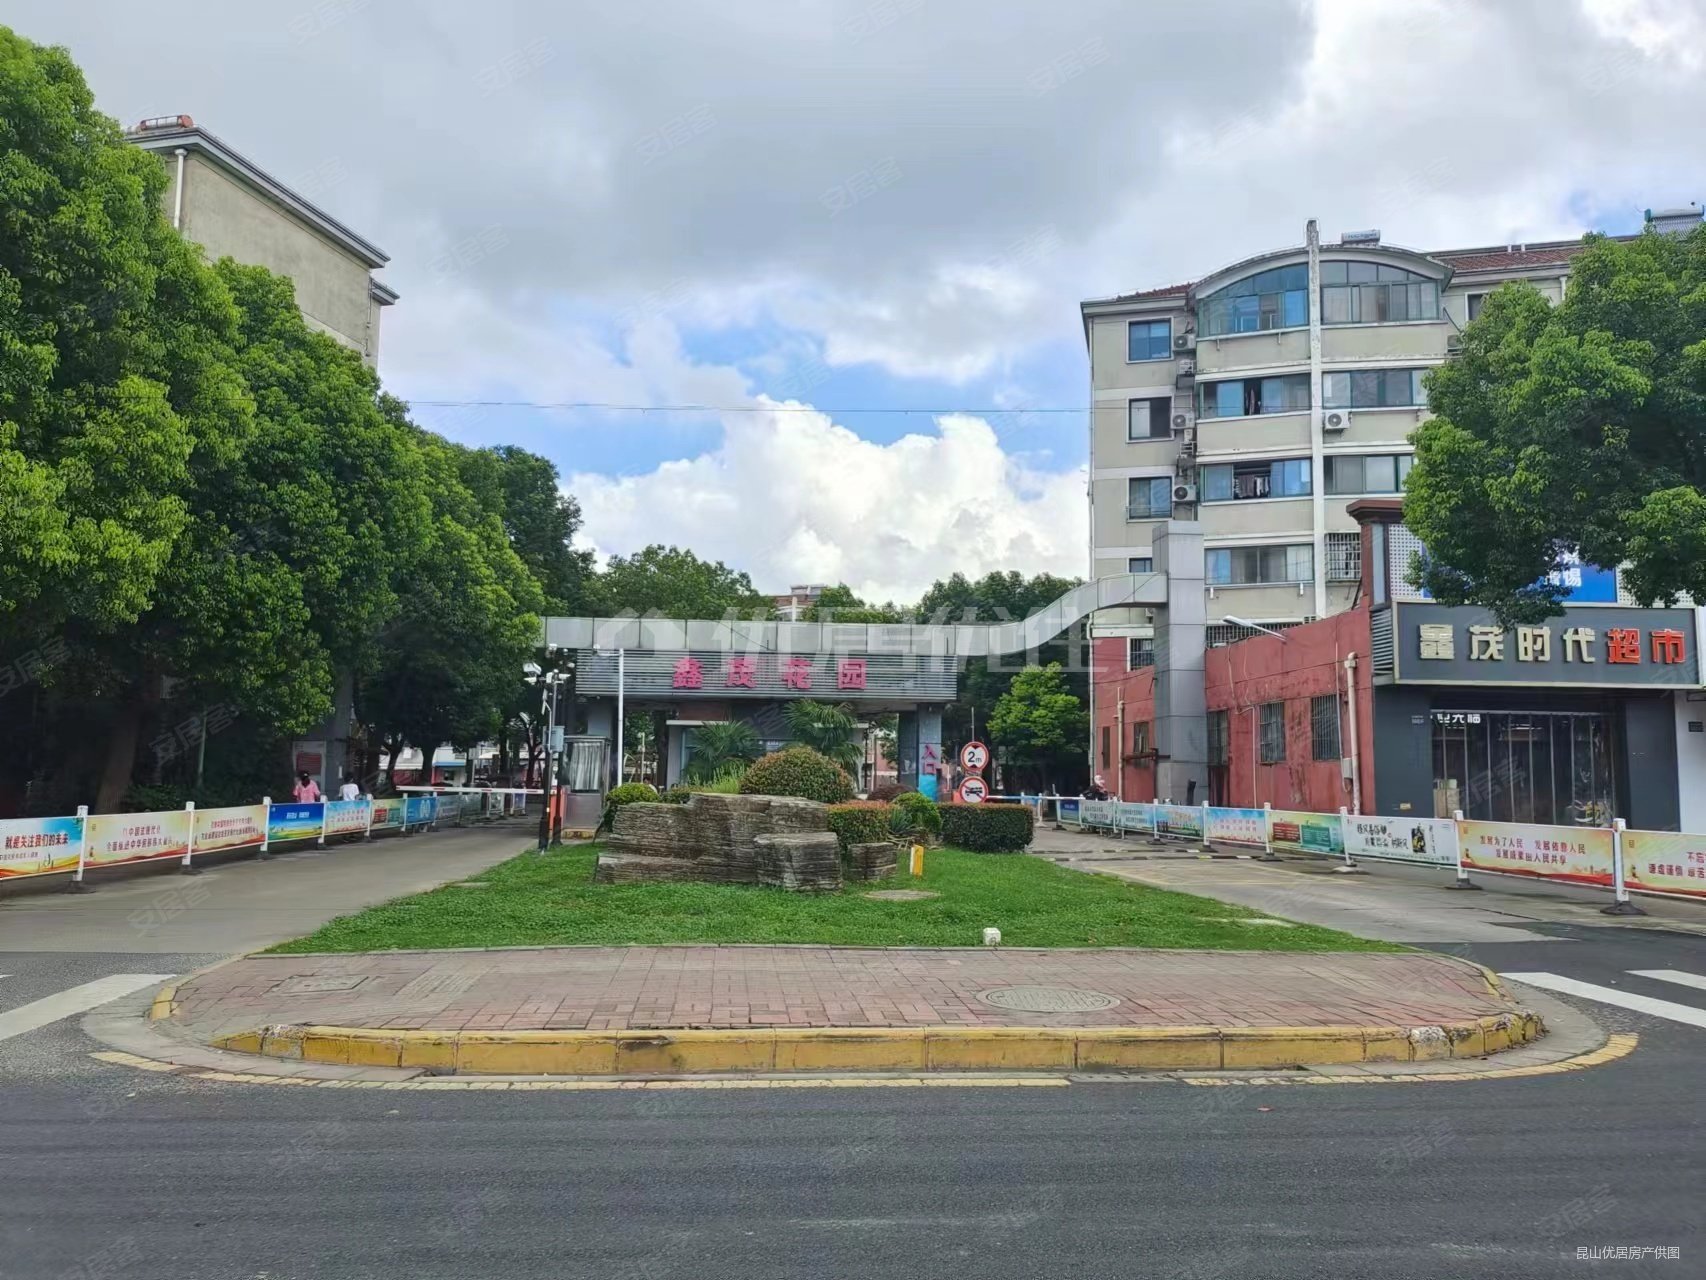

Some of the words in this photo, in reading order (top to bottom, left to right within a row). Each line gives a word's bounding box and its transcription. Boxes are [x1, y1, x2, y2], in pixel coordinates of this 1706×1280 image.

[1420, 624, 1686, 664] 鑫茂时代超市
[672, 657, 867, 689] 鑫茂花园
[922, 744, 937, 775] 入口
